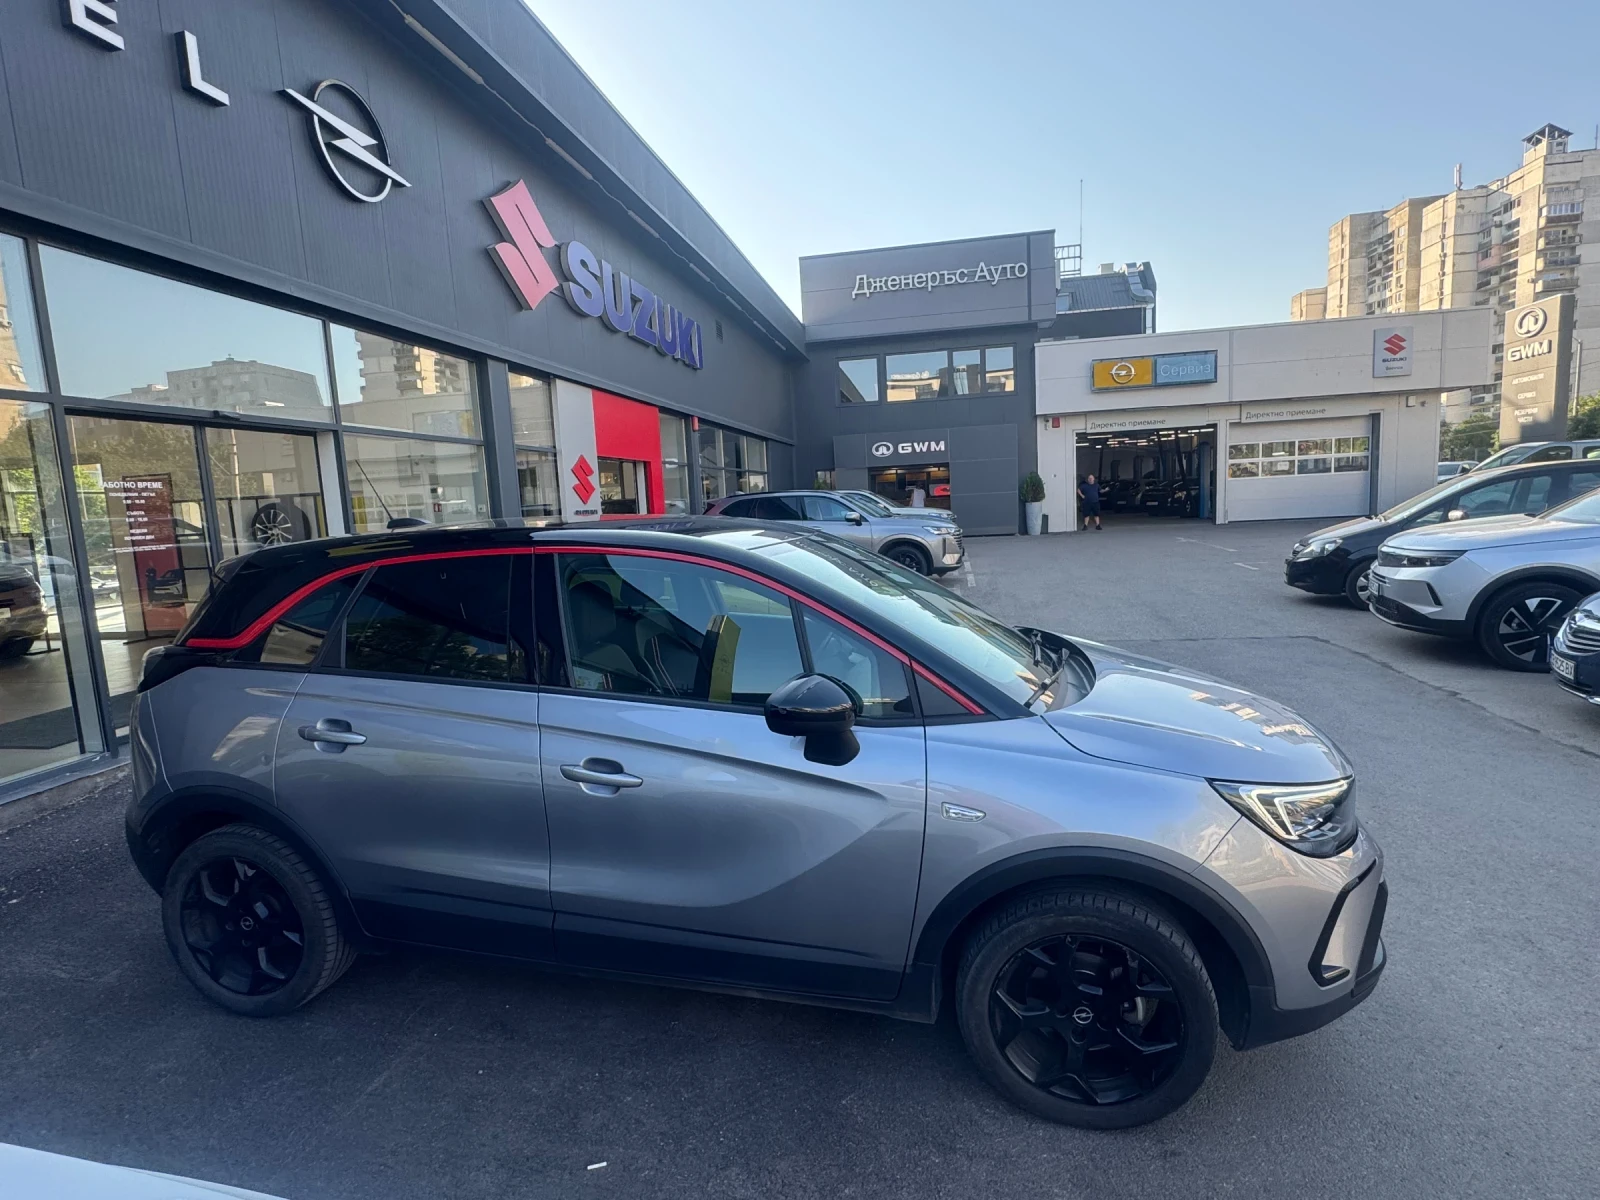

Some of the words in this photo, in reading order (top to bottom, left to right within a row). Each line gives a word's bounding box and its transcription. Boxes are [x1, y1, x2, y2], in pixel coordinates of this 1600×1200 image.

[851, 267, 968, 299] Дженеръс
[973, 261, 1028, 286] Ауто
[560, 240, 703, 369] SUZUKI
[1507, 339, 1551, 361] GWM
[1160, 363, 1211, 377] Сервиз
[1246, 411, 1284, 420] Директно
[1285, 408, 1326, 417] приемане
[1090, 421, 1127, 430] Директно
[1128, 419, 1166, 427] приемане
[898, 440, 945, 454] GWM
[99, 481, 136, 489] АБОТНО
[137, 481, 163, 489] ВРЕМЕ
